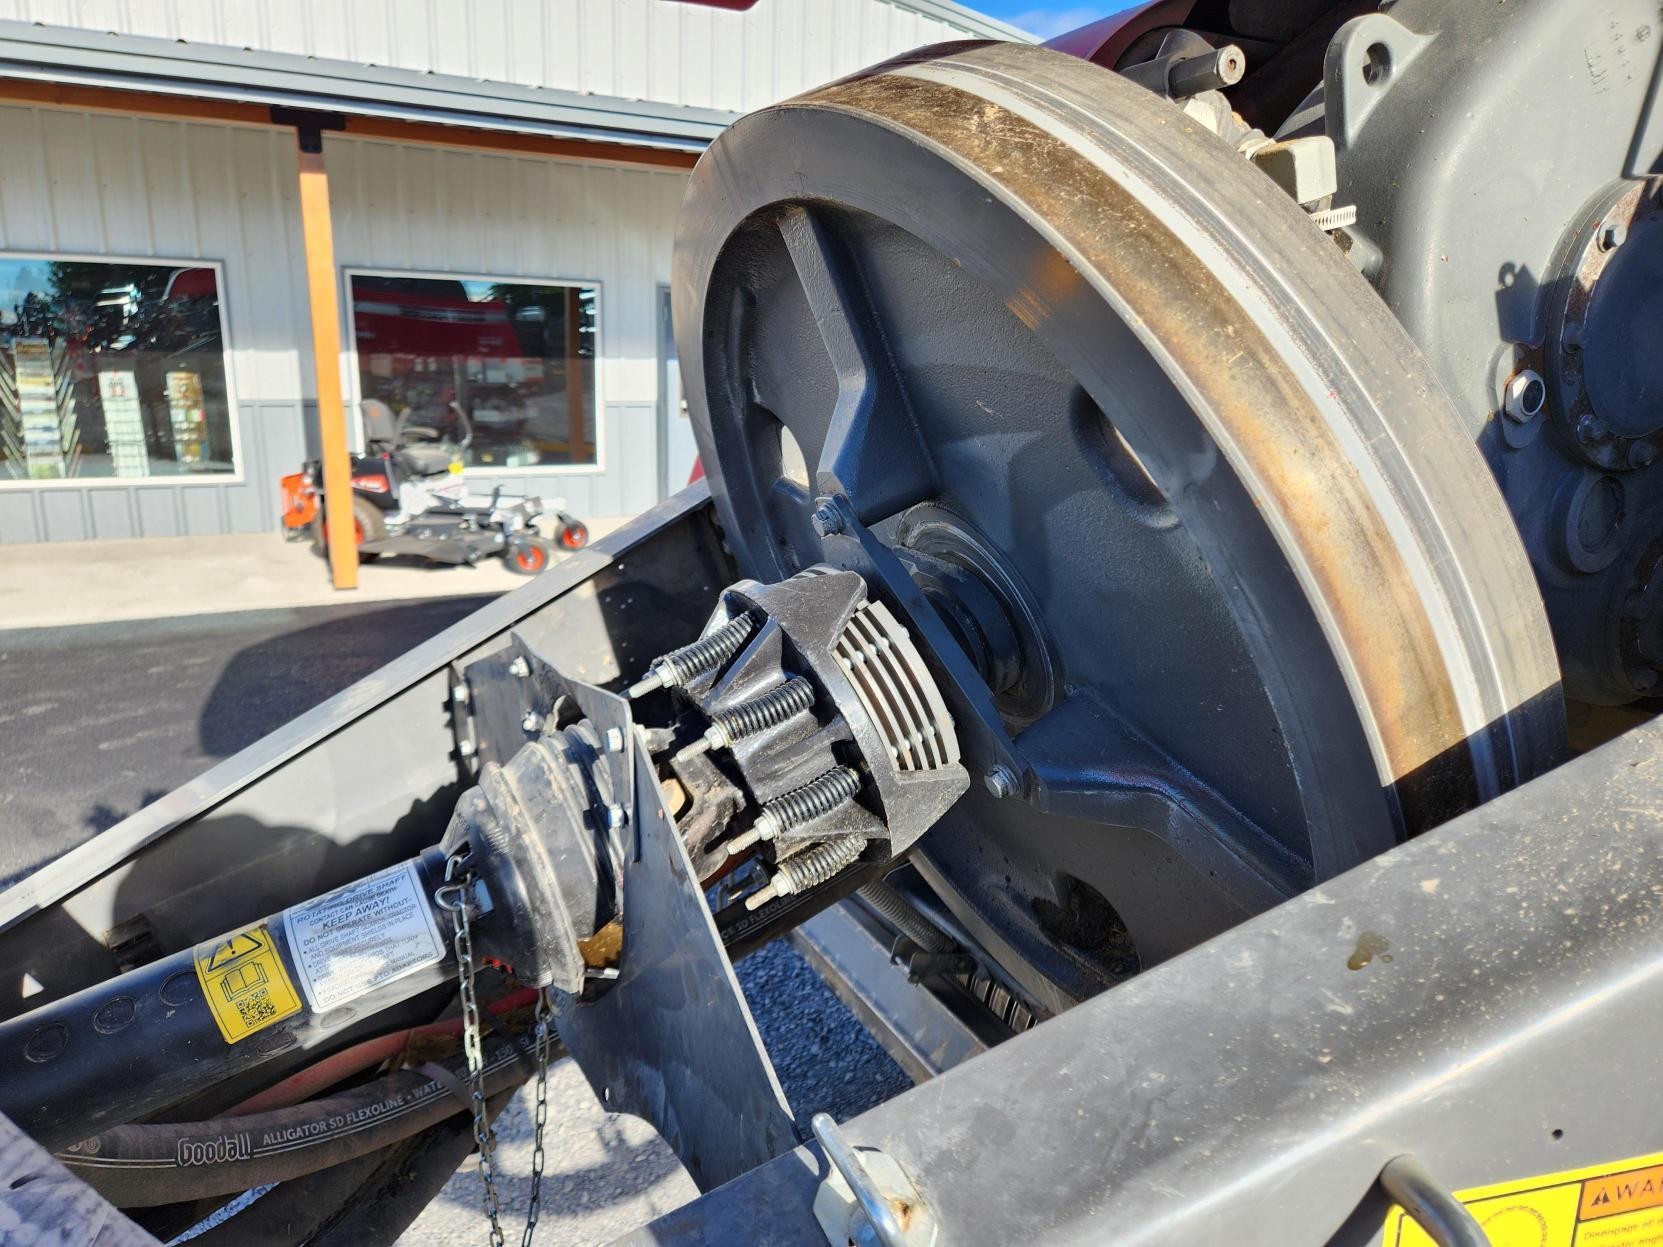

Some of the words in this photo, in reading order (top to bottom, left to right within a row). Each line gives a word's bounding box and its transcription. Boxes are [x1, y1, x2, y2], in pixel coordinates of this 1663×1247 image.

[296, 900, 344, 923] ROTATING
[344, 887, 373, 904] DRIVE
[376, 874, 405, 890] SHAFT
[309, 910, 338, 925] CONTACT
[339, 904, 353, 913] CAN
[320, 911, 353, 930] KEEP
[353, 896, 390, 916] AWAY!
[303, 936, 316, 946] DO
[316, 929, 334, 940] NOT
[334, 913, 372, 933] OPERATE
[319, 936, 339, 948] DRIVE
[176, 1132, 251, 1167] Goodall
[263, 1121, 328, 1146] ALLIGATOR
[329, 1114, 344, 1130] SD
[346, 1095, 404, 1125] FLEXOLINE
[412, 1080, 444, 1100] WATE
